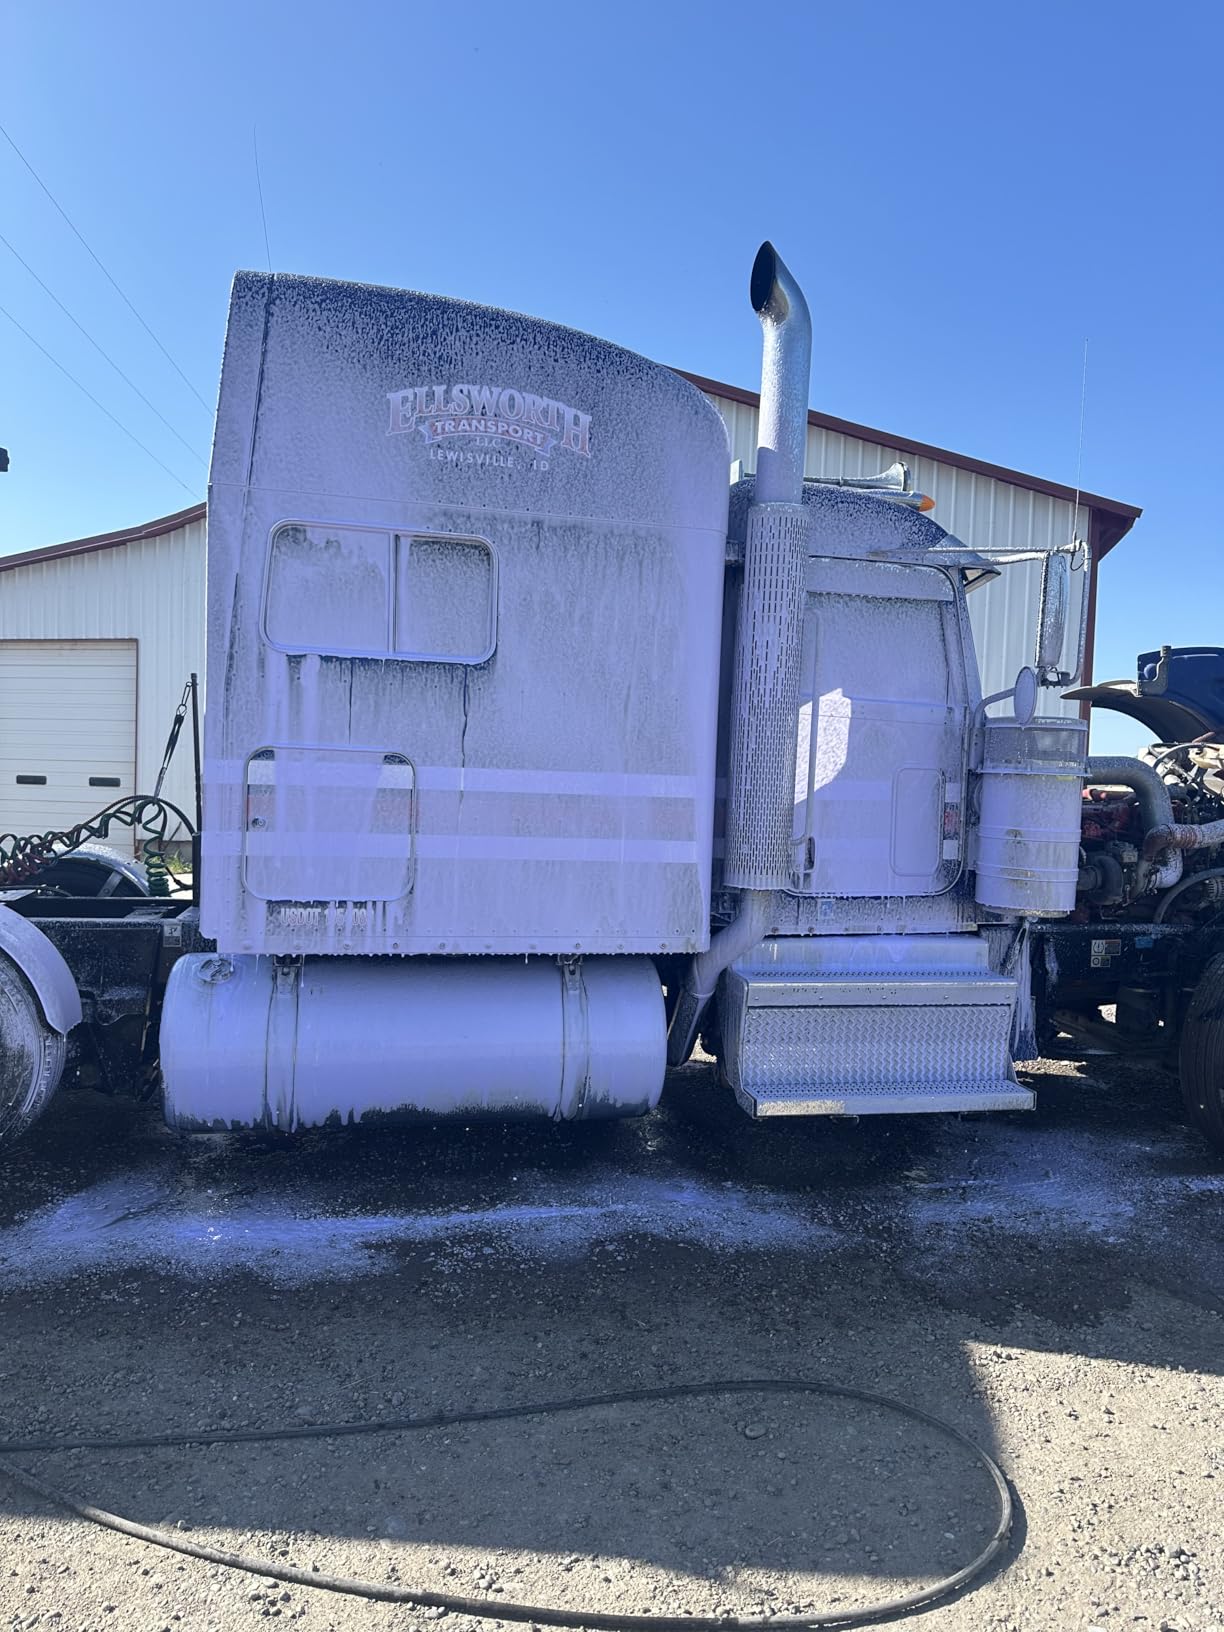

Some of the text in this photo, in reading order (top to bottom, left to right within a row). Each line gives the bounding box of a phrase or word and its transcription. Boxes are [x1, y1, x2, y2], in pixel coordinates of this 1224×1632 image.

[385, 384, 592, 458] ELLSWORTH
[435, 419, 544, 445] TRANSPORT
[533, 459, 549, 470] ID
[280, 908, 321, 925] USDOT
